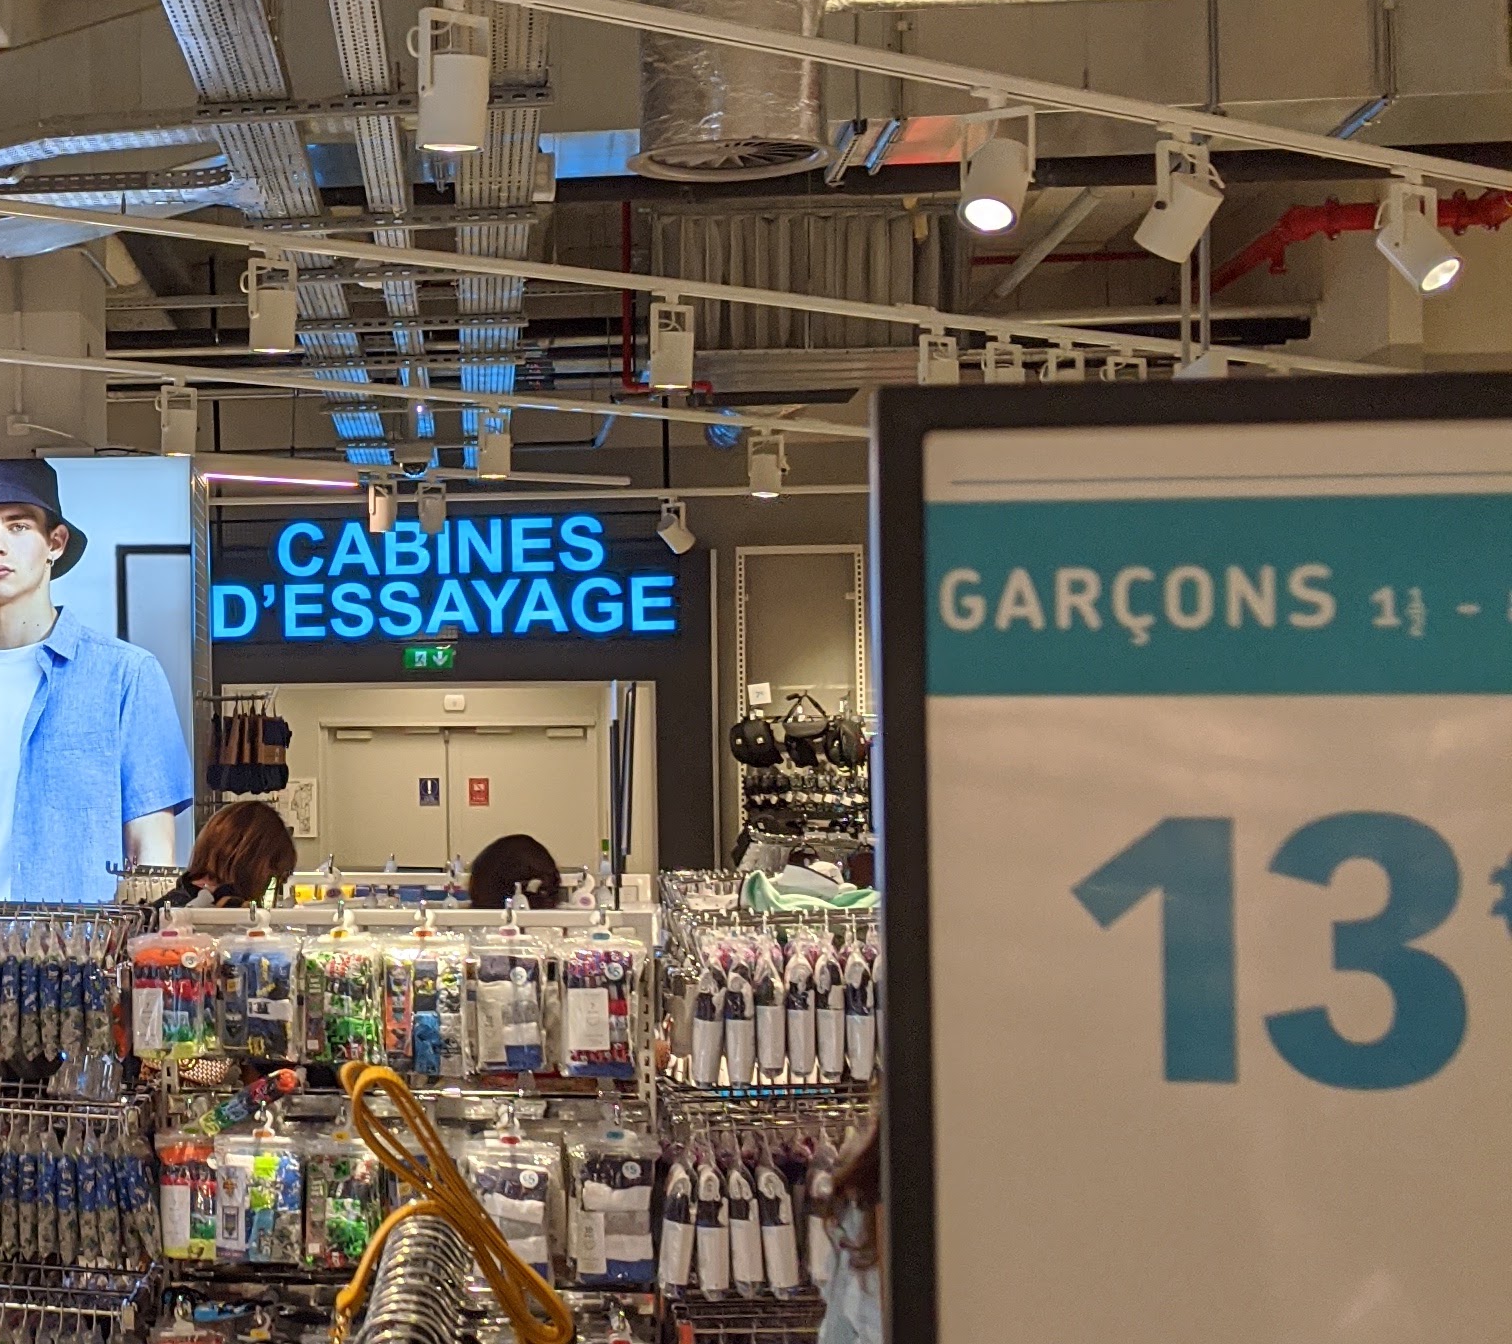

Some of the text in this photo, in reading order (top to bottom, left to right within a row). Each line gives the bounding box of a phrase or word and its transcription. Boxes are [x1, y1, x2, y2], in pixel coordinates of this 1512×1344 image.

[278, 516, 604, 576] CABINES
[213, 575, 676, 638] D'ESSAYAGE
[939, 563, 1337, 647] GARÇONS
